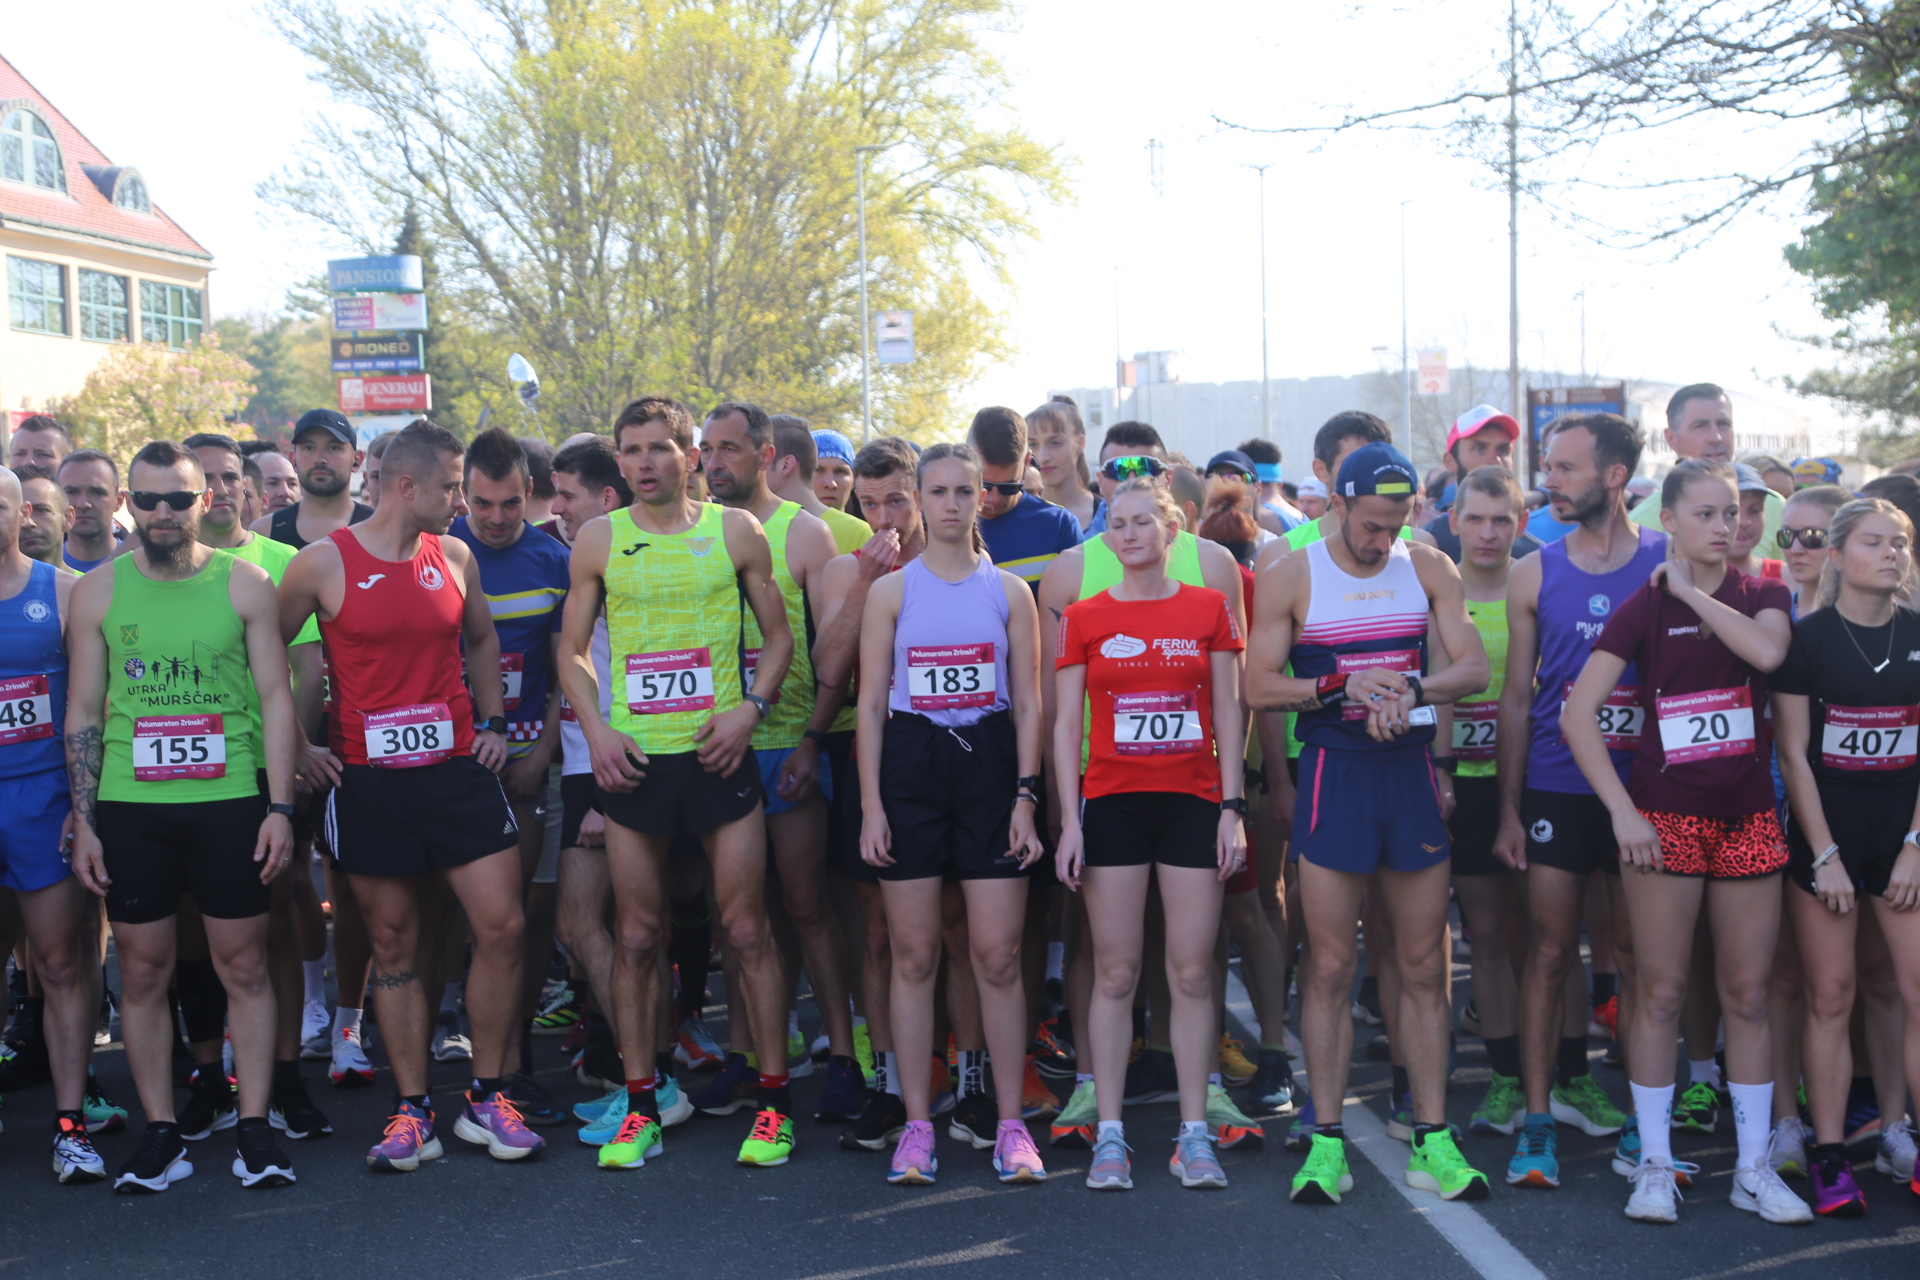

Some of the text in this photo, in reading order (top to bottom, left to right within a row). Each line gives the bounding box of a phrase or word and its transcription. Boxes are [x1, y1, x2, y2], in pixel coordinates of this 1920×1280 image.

[364, 381, 424, 395] GENERALI
[1343, 589, 1396, 603] saucony
[1668, 626, 1699, 636] ZRINSKI
[1152, 638, 1198, 650] FERIVI
[629, 655, 669, 665] Polumaraton
[911, 650, 953, 658] Polumaraton
[1161, 648, 1201, 660] sport
[1341, 658, 1384, 667] Polumaraton
[642, 670, 697, 700] 570
[924, 666, 980, 694] 183
[127, 683, 167, 696] UTRKA
[1118, 695, 1160, 704] Polumaraton
[1661, 696, 1707, 710] Polumaraton
[368, 710, 410, 721] Polumaraton
[1830, 709, 1877, 719] Polumaraton
[137, 720, 180, 728] Polumaraton
[1129, 713, 1185, 741] 707
[1688, 712, 1730, 744] 20
[381, 723, 440, 755] 308
[1461, 721, 1496, 746] 22
[1838, 729, 1903, 756] 407
[149, 736, 209, 765] 155
